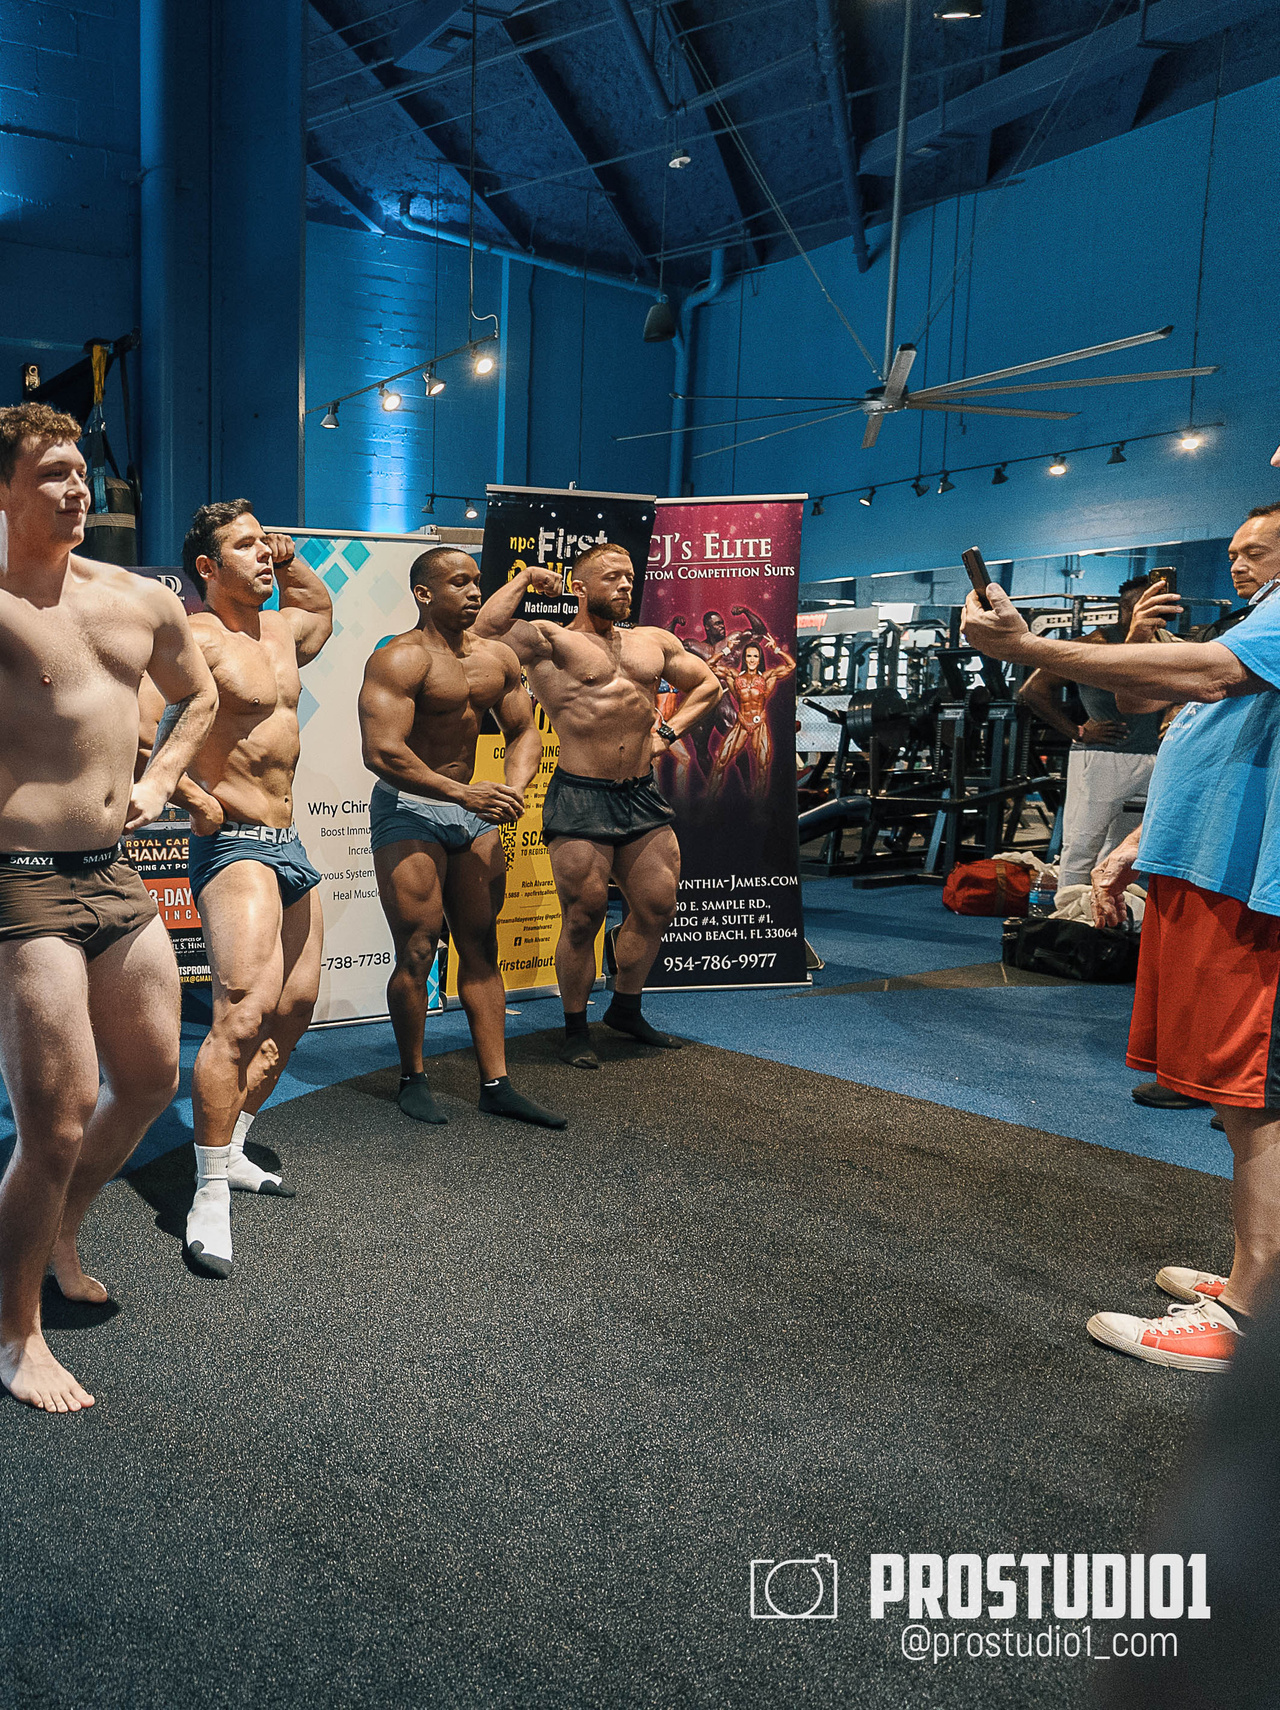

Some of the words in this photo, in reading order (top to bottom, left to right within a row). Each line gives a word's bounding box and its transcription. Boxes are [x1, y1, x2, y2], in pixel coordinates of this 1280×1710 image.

[509, 536, 535, 553] npc
[677, 566, 760, 580] COMPETITION
[763, 563, 795, 577] SUITS
[524, 601, 561, 614] National
[307, 801, 339, 818] Why
[320, 827, 345, 838] Boost
[126, 839, 162, 848] ROYAL
[127, 847, 190, 862] HAMAS
[136, 864, 157, 872] DING
[159, 863, 173, 871] AT
[345, 868, 375, 882] System
[333, 890, 352, 901] Heal
[690, 901, 699, 911] E.
[701, 899, 746, 911] SAMPLE
[722, 914, 755, 926] SUITE
[750, 929, 763, 940] FL
[764, 928, 798, 939] 33064
[320, 951, 391, 971] -738-7738
[663, 952, 778, 973] 954-786-9977
